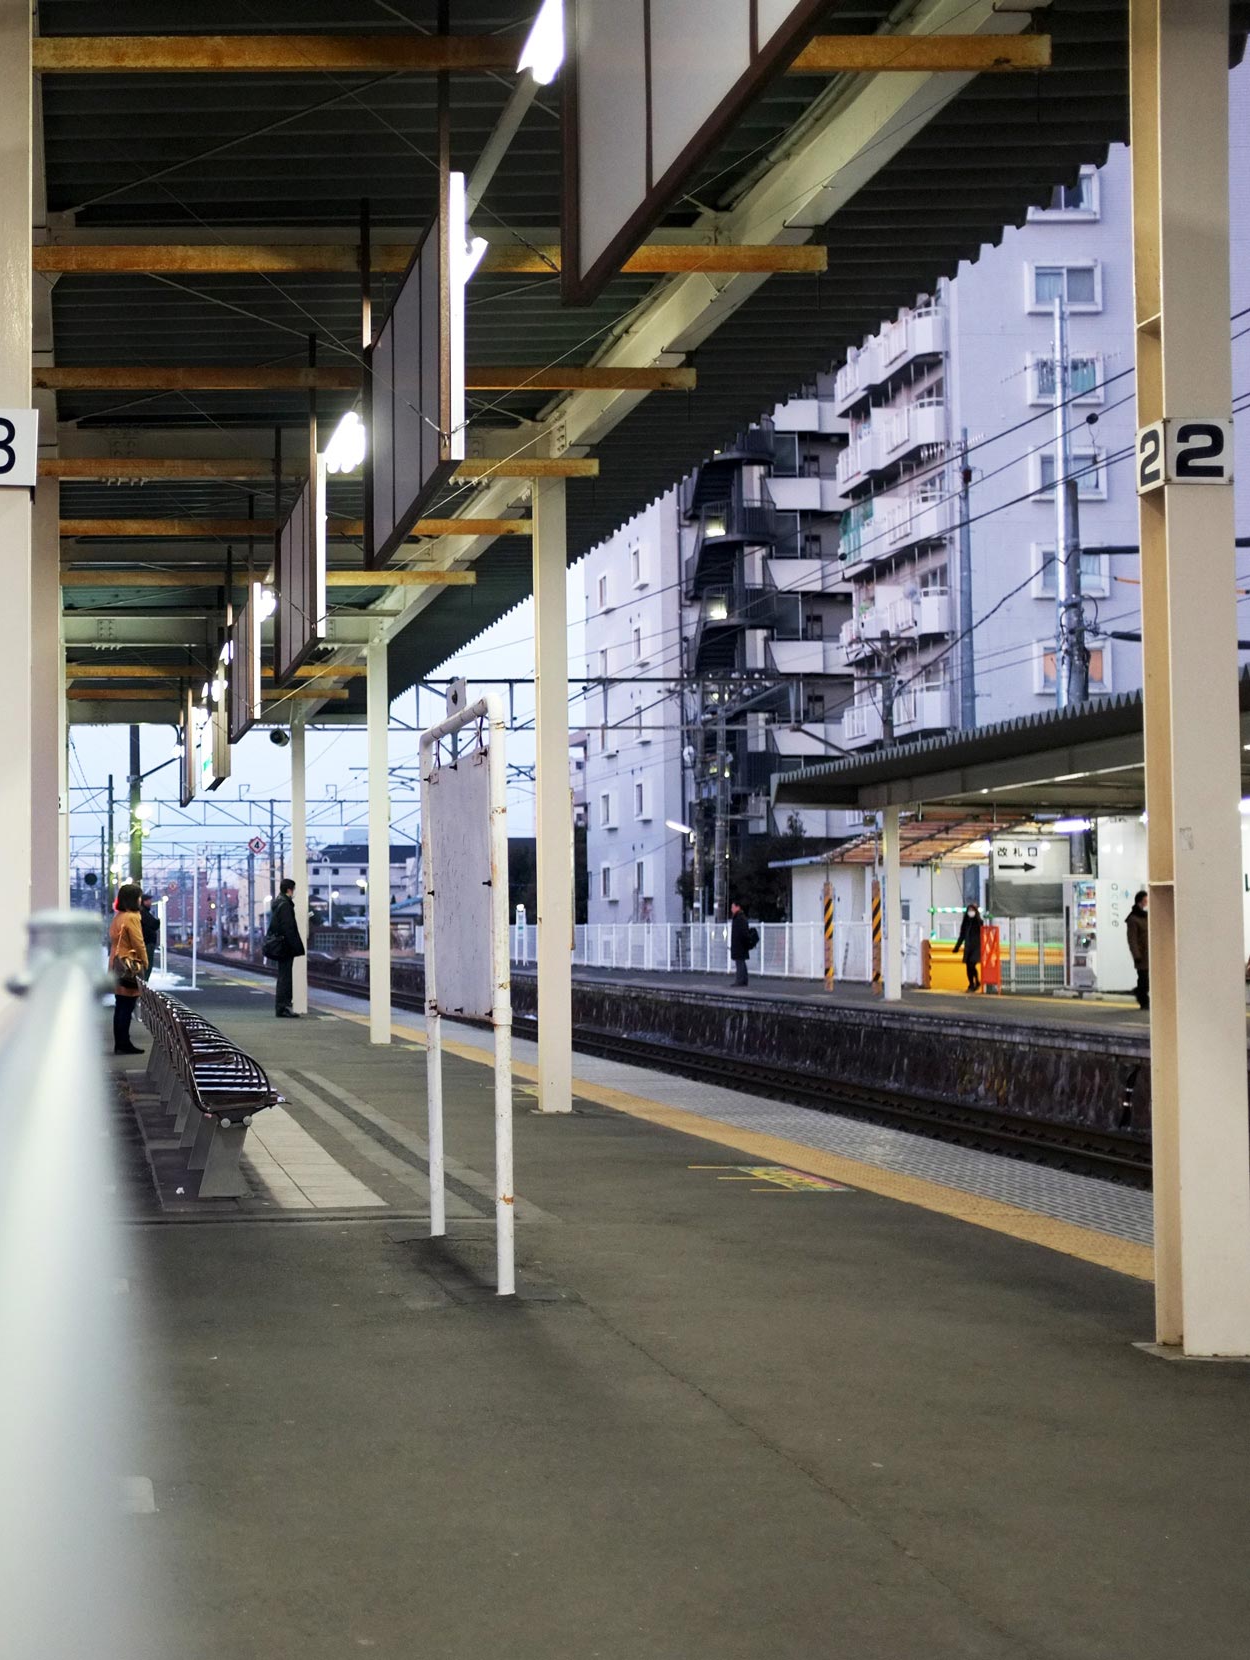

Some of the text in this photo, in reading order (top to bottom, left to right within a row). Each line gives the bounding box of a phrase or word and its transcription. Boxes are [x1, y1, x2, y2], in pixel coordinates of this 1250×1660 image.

[1139, 428, 1161, 487] 2
[1175, 423, 1225, 478] 2
[254, 841, 260, 849] 4
[997, 847, 1038, 857] 改札口
